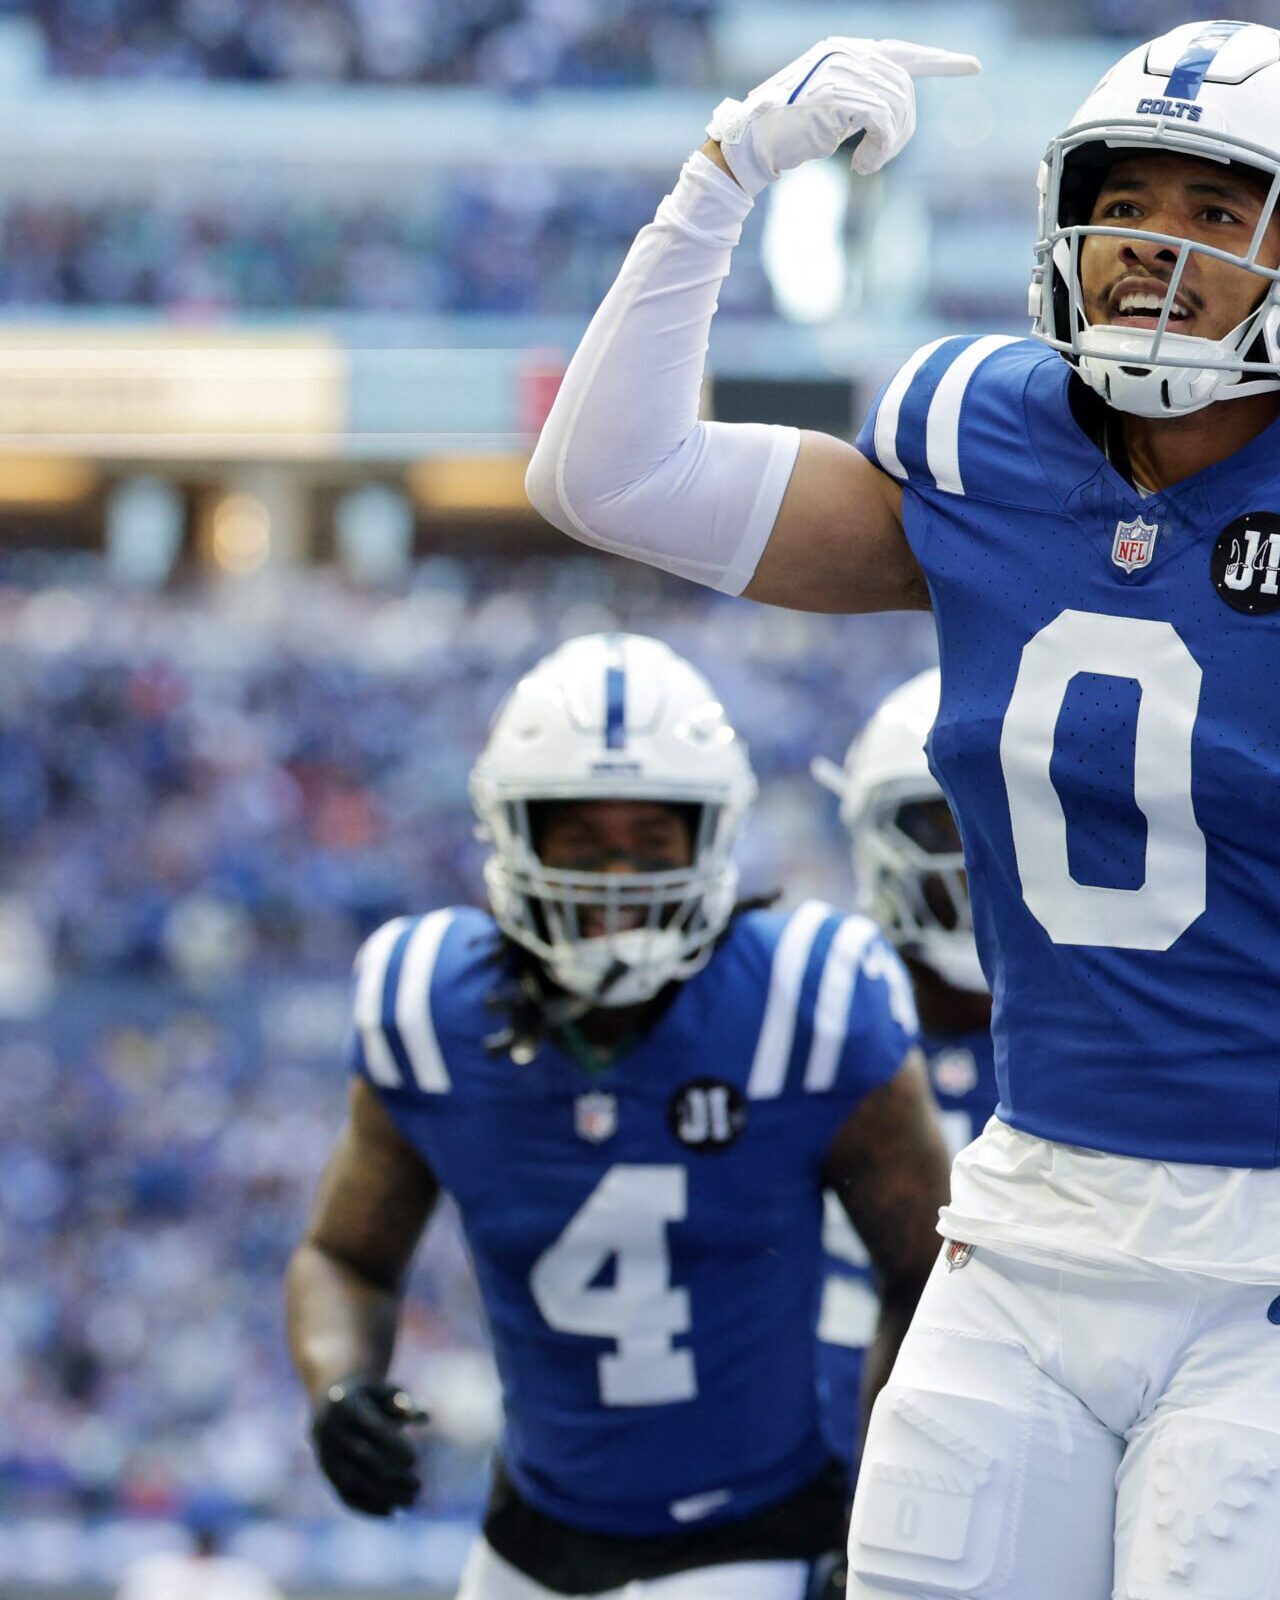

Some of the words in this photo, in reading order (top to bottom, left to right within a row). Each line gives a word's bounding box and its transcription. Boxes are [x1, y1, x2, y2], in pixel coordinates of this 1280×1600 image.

[1136, 98, 1203, 122] COLTS
[1118, 540, 1146, 562] NFL
[1000, 608, 1207, 952] 0
[529, 1163, 698, 1408] 4
